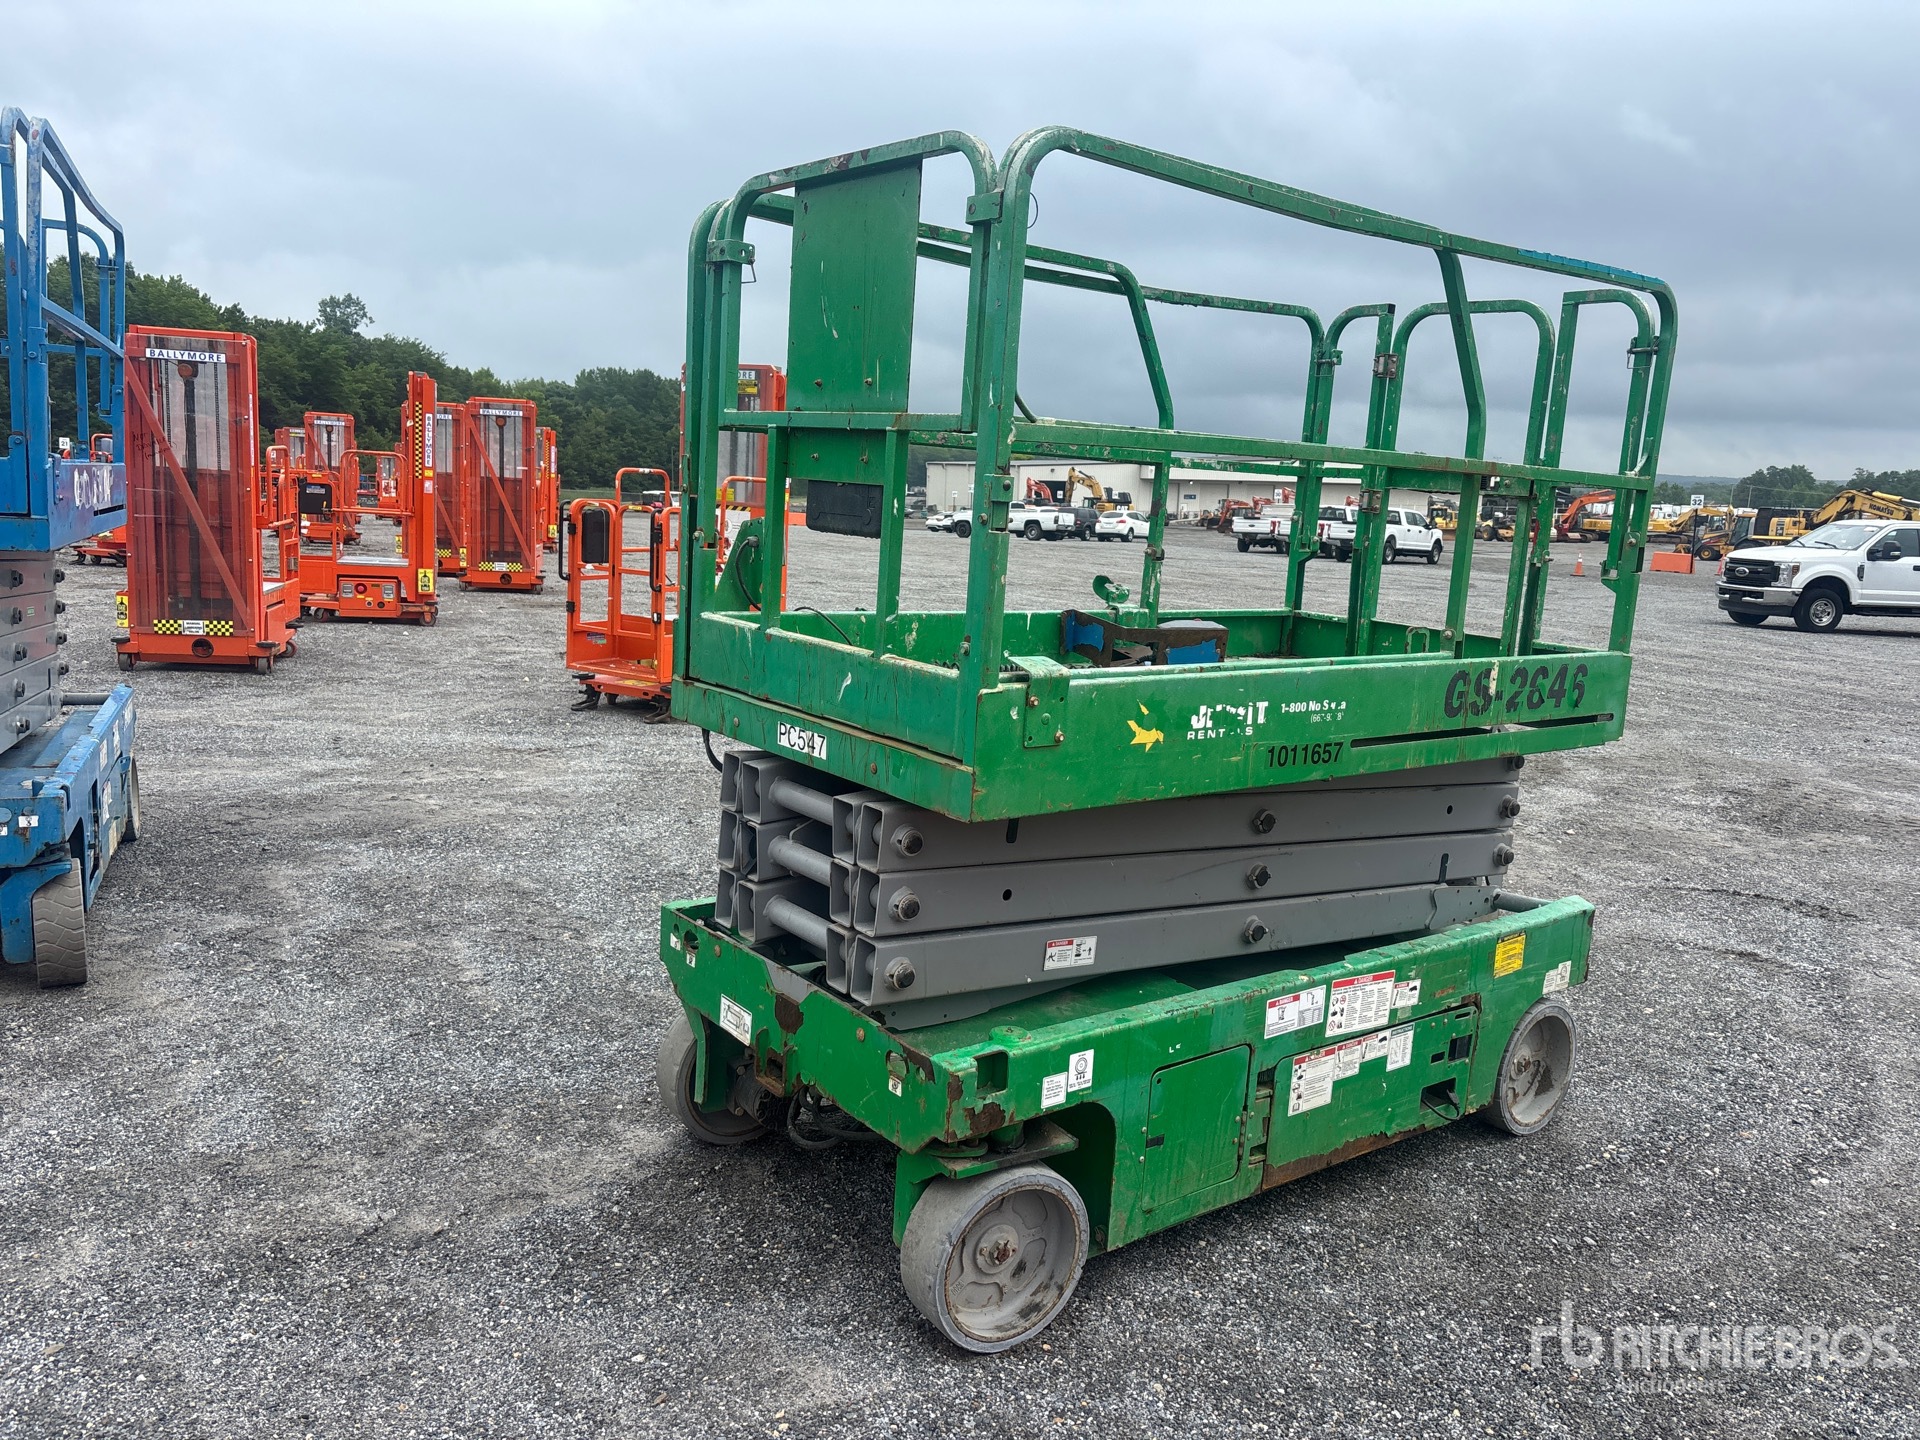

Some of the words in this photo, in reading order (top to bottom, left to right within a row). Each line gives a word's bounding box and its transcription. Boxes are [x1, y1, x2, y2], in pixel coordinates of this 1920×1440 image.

[149, 348, 222, 362] BALLYMORE
[480, 408, 521, 417] BALLYMORE
[1691, 498, 1703, 506] 32
[1868, 502, 1895, 516] KOMATSU
[1280, 702, 1307, 714] 1-800
[1308, 700, 1321, 712] No
[778, 721, 826, 757] PC547
[1186, 726, 1254, 741] RENTS
[1267, 741, 1344, 768] 1011657
[1357, 975, 1374, 984] DANGER
